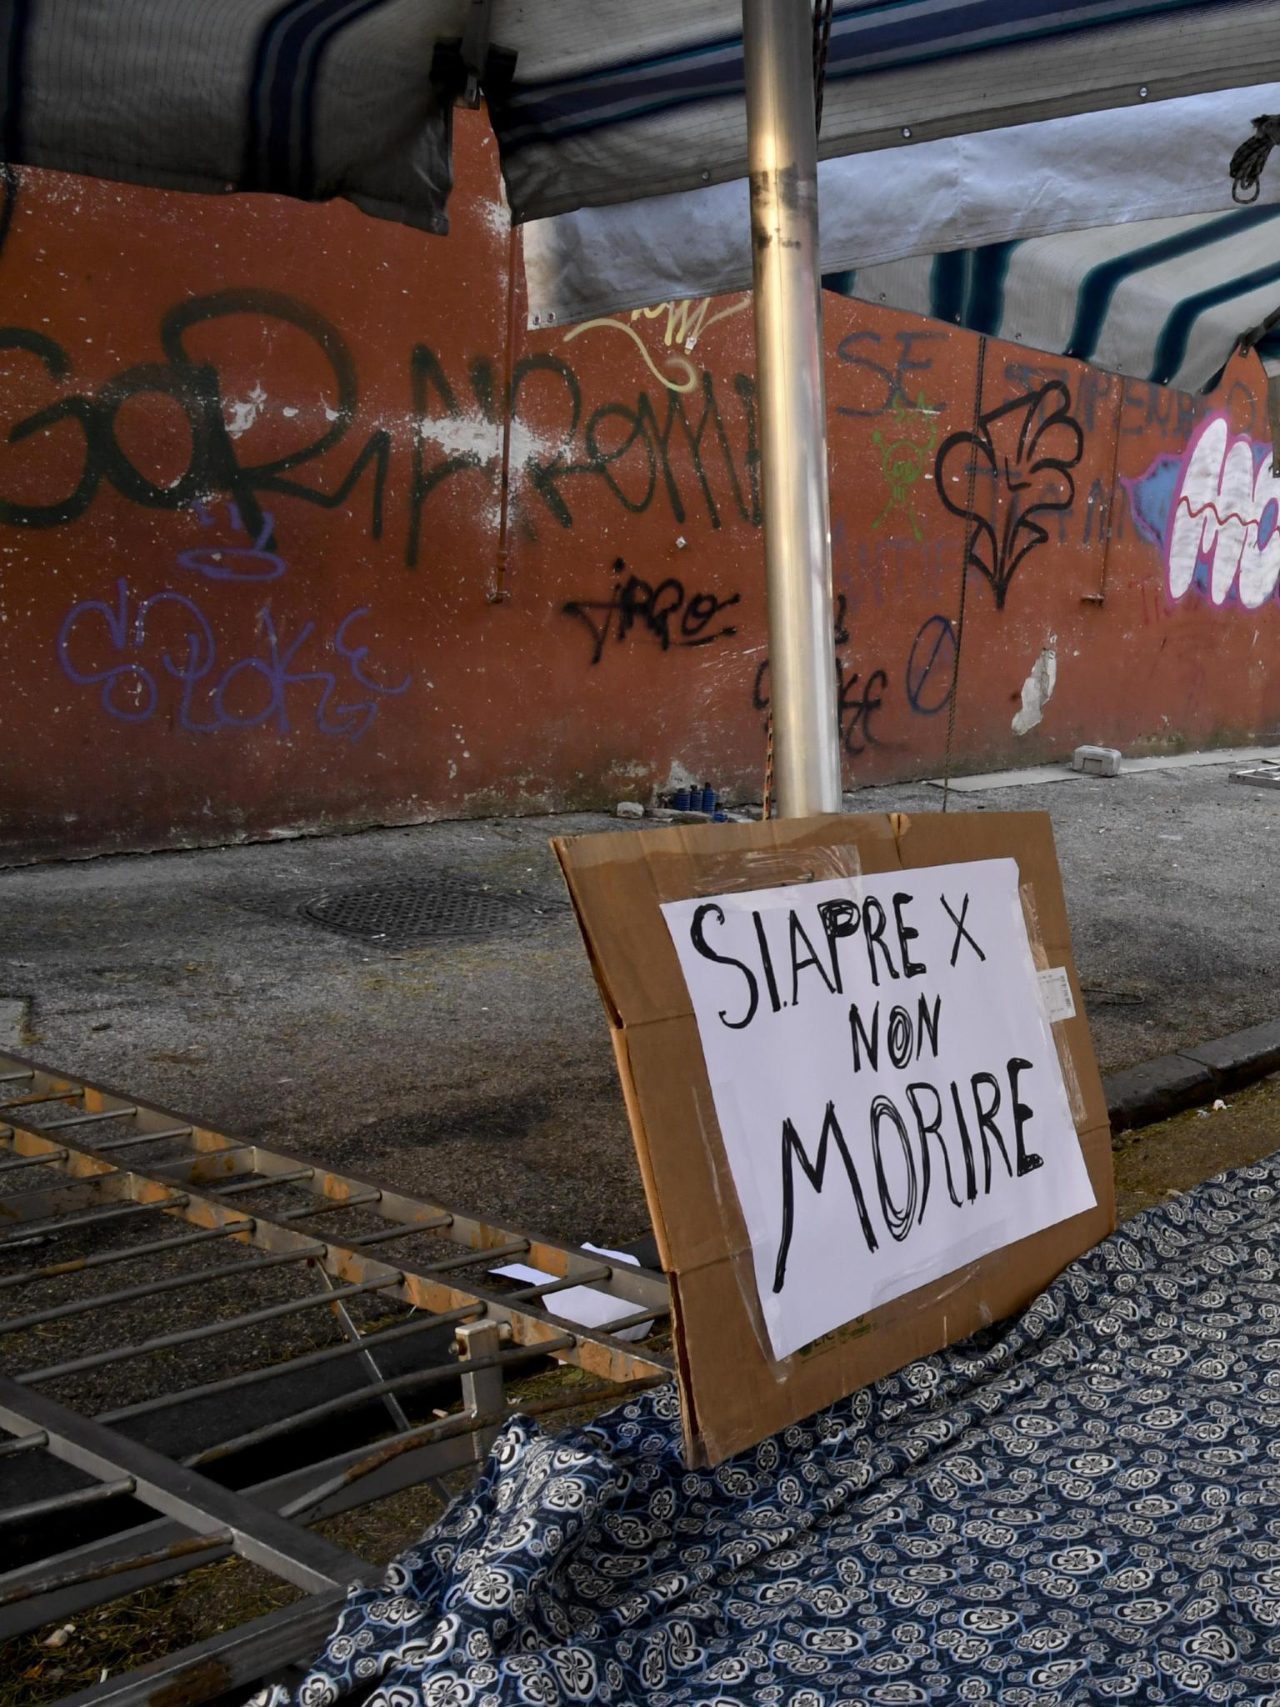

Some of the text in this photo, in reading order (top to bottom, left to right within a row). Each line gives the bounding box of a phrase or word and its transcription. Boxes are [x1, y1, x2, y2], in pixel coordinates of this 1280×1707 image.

[940, 893, 986, 968] X
[848, 992, 941, 1073] NON
[772, 1057, 1044, 1294] MORIRE
